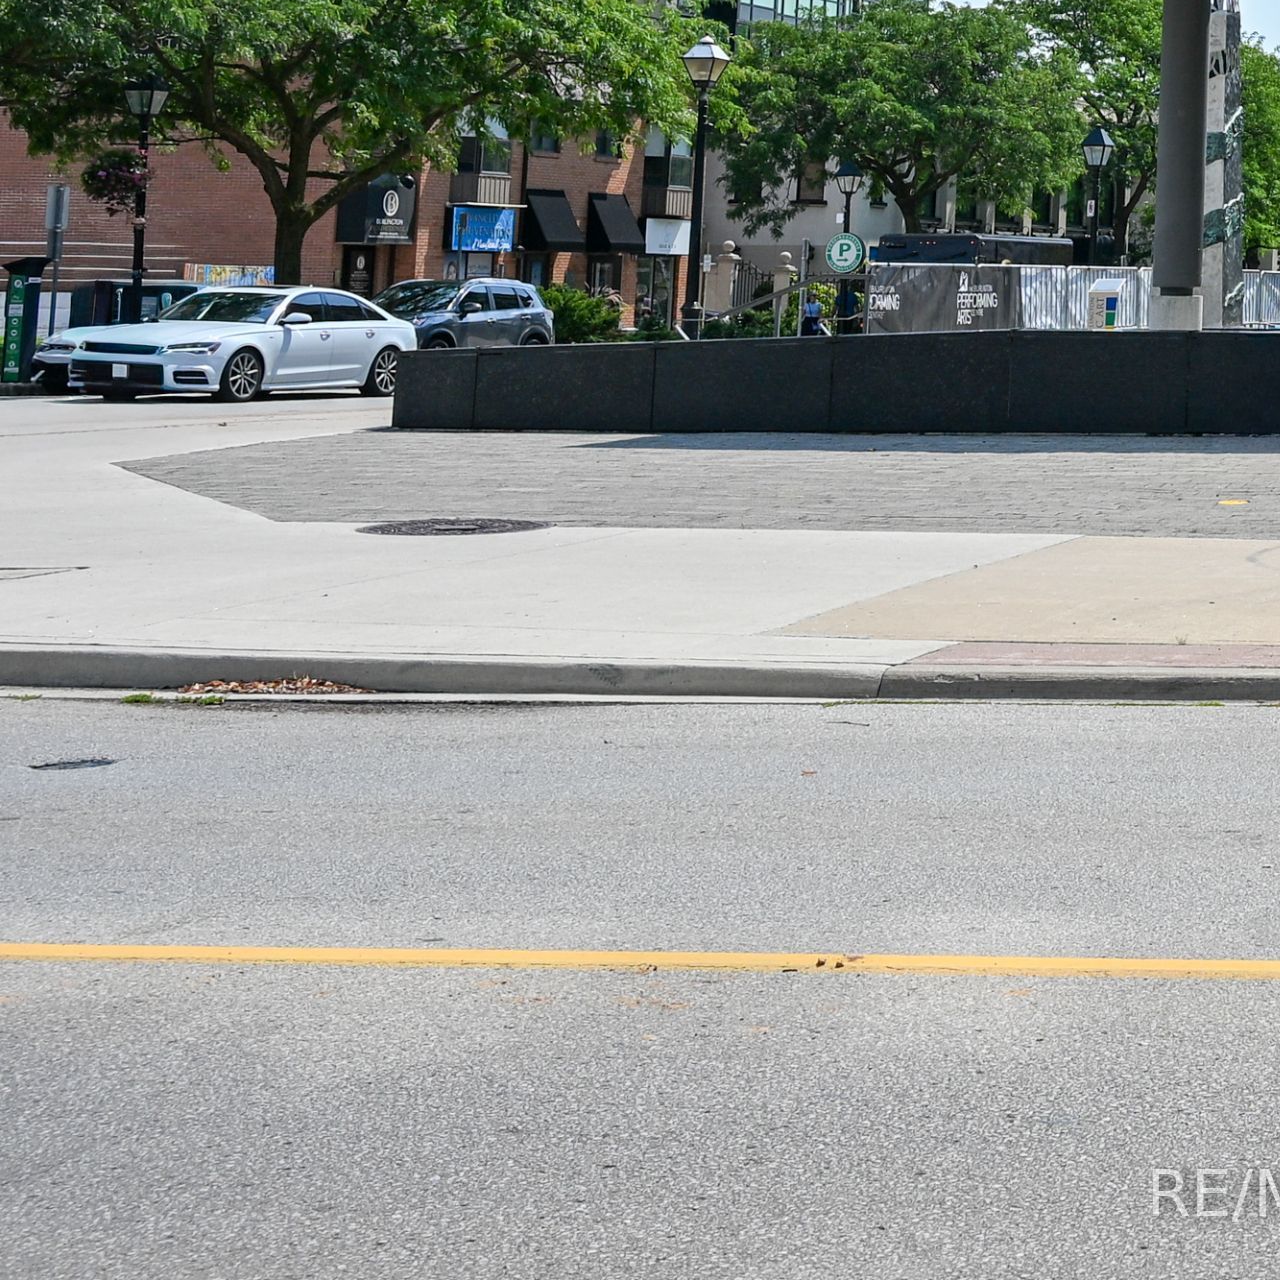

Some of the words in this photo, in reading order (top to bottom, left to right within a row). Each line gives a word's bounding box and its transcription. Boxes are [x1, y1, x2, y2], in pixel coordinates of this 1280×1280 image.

[839, 243, 851, 257] P
[957, 293, 998, 309] PERFORMING
[957, 310, 972, 325] ARTS
